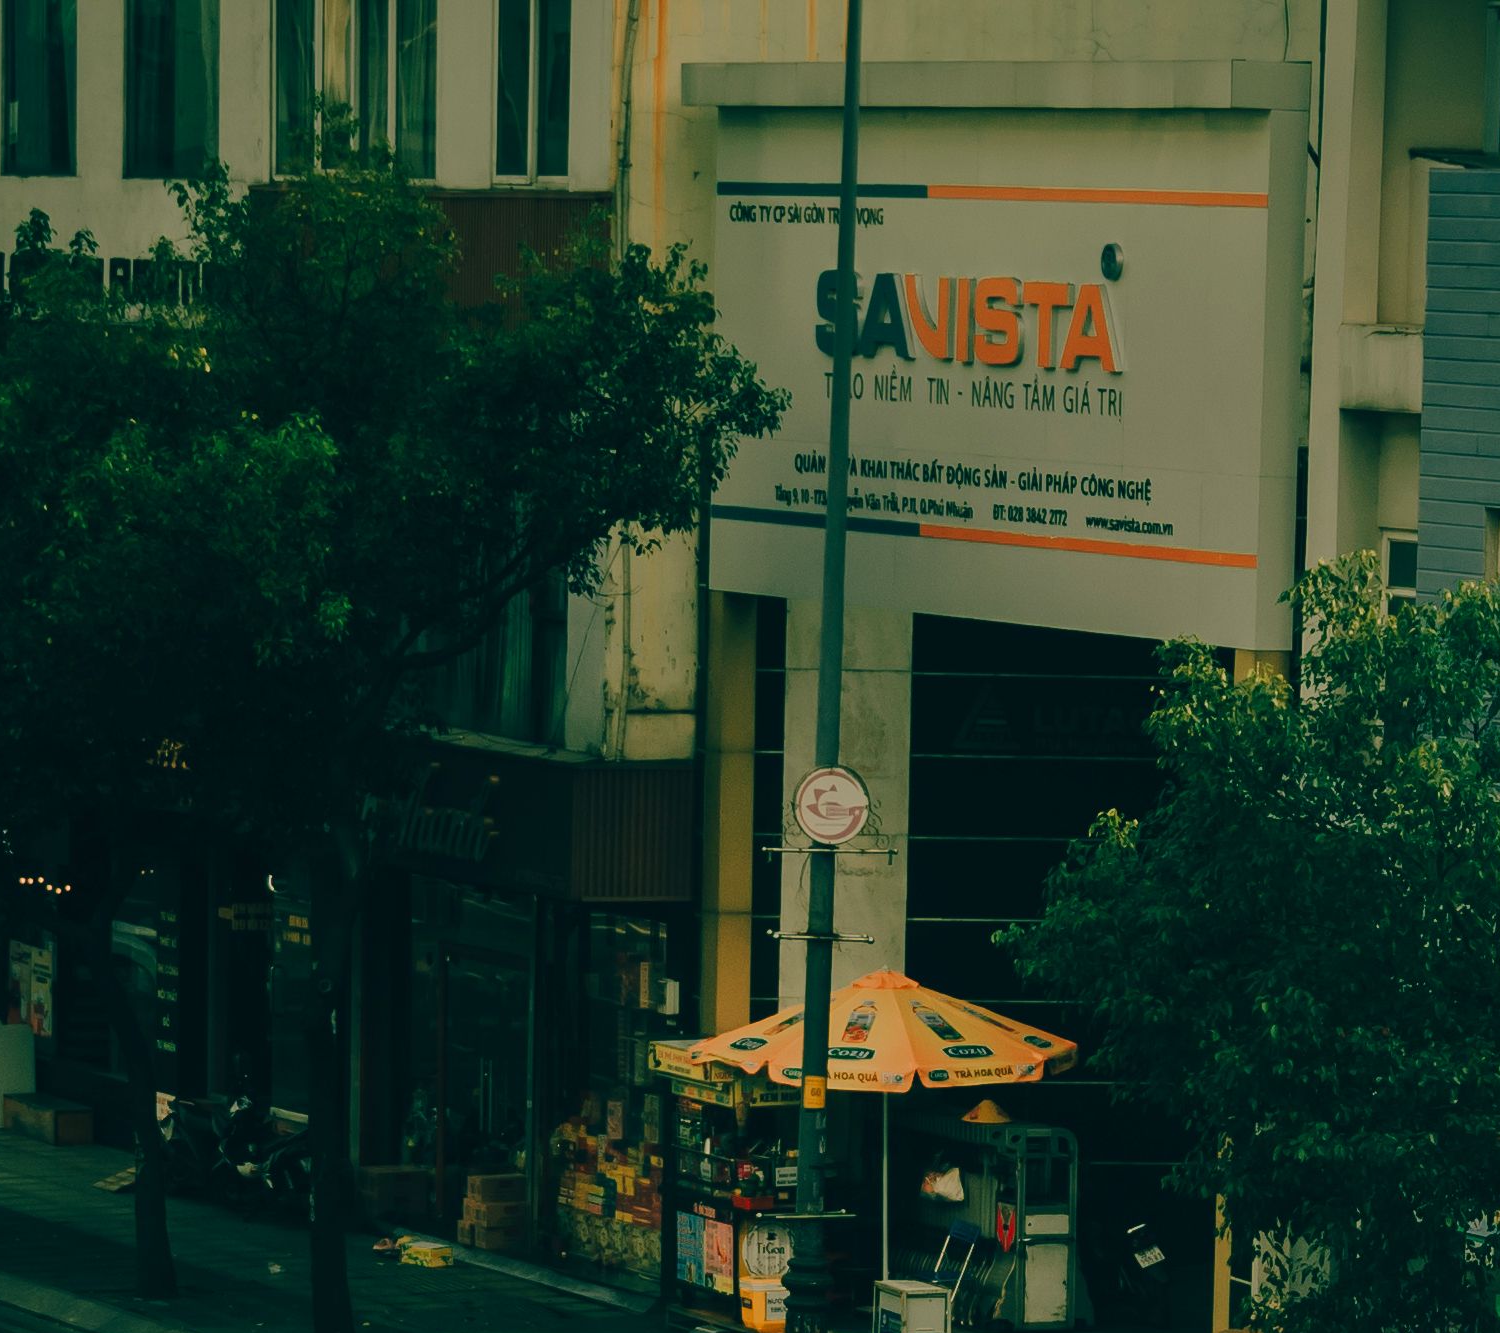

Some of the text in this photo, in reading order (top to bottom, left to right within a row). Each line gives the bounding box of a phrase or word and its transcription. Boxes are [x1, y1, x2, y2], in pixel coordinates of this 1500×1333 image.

[729, 201, 757, 223] CÔNG
[759, 206, 772, 223] TY
[773, 206, 786, 224] CP
[804, 202, 825, 225] GÒN
[815, 270, 1124, 375] SAVISTA
[825, 372, 864, 403] TO
[874, 365, 913, 403] NIỀM
[927, 377, 950, 406] TIN
[972, 376, 1015, 410] NÂNG
[1063, 382, 1090, 416] GIÁ
[1097, 388, 1123, 424] TRỊ
[795, 450, 826, 475] QUẢN
[860, 459, 888, 481] KHAI
[890, 459, 920, 483] THÁC
[923, 458, 944, 485] BẤT
[946, 463, 980, 490] ĐỘNG
[984, 464, 1008, 489] SẢN
[1018, 467, 1042, 492] GIẢI
[1046, 471, 1077, 495] PHÁP
[1080, 473, 1114, 498] CÔNG
[1117, 479, 1152, 506] NGHỆ
[828, 1047, 870, 1060] Cozy
[947, 1045, 988, 1058] Cozy
[834, 1071, 855, 1082] HOA
[955, 1067, 972, 1080] TRÀ
[975, 1066, 992, 1077] HOA
